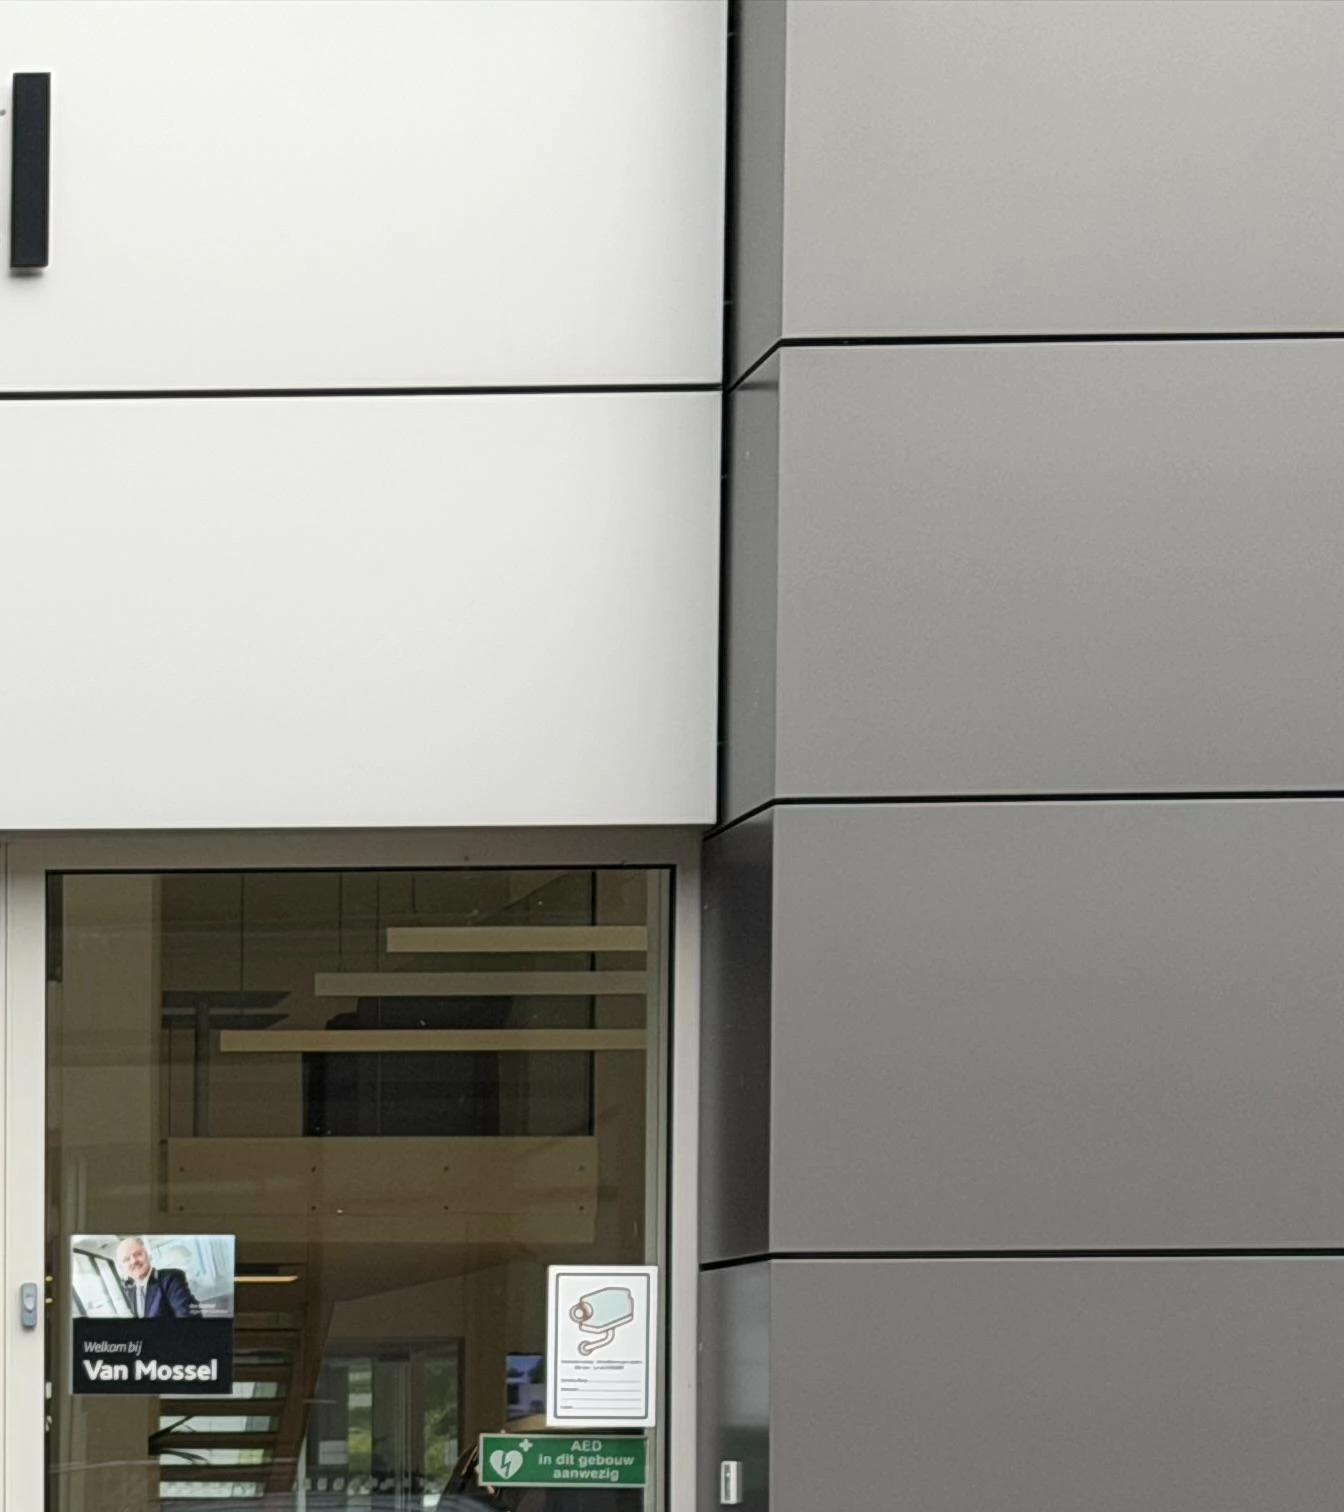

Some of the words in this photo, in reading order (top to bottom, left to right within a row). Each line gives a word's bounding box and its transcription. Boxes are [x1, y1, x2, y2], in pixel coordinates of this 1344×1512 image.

[83, 1341, 127, 1353] Welkom
[128, 1341, 143, 1356] bij
[83, 1360, 128, 1381] Van
[135, 1359, 218, 1381] Mossel
[571, 1440, 602, 1451] AED
[556, 1454, 574, 1465] dit
[578, 1454, 635, 1468] gebouw
[553, 1468, 619, 1481] aanwezig
